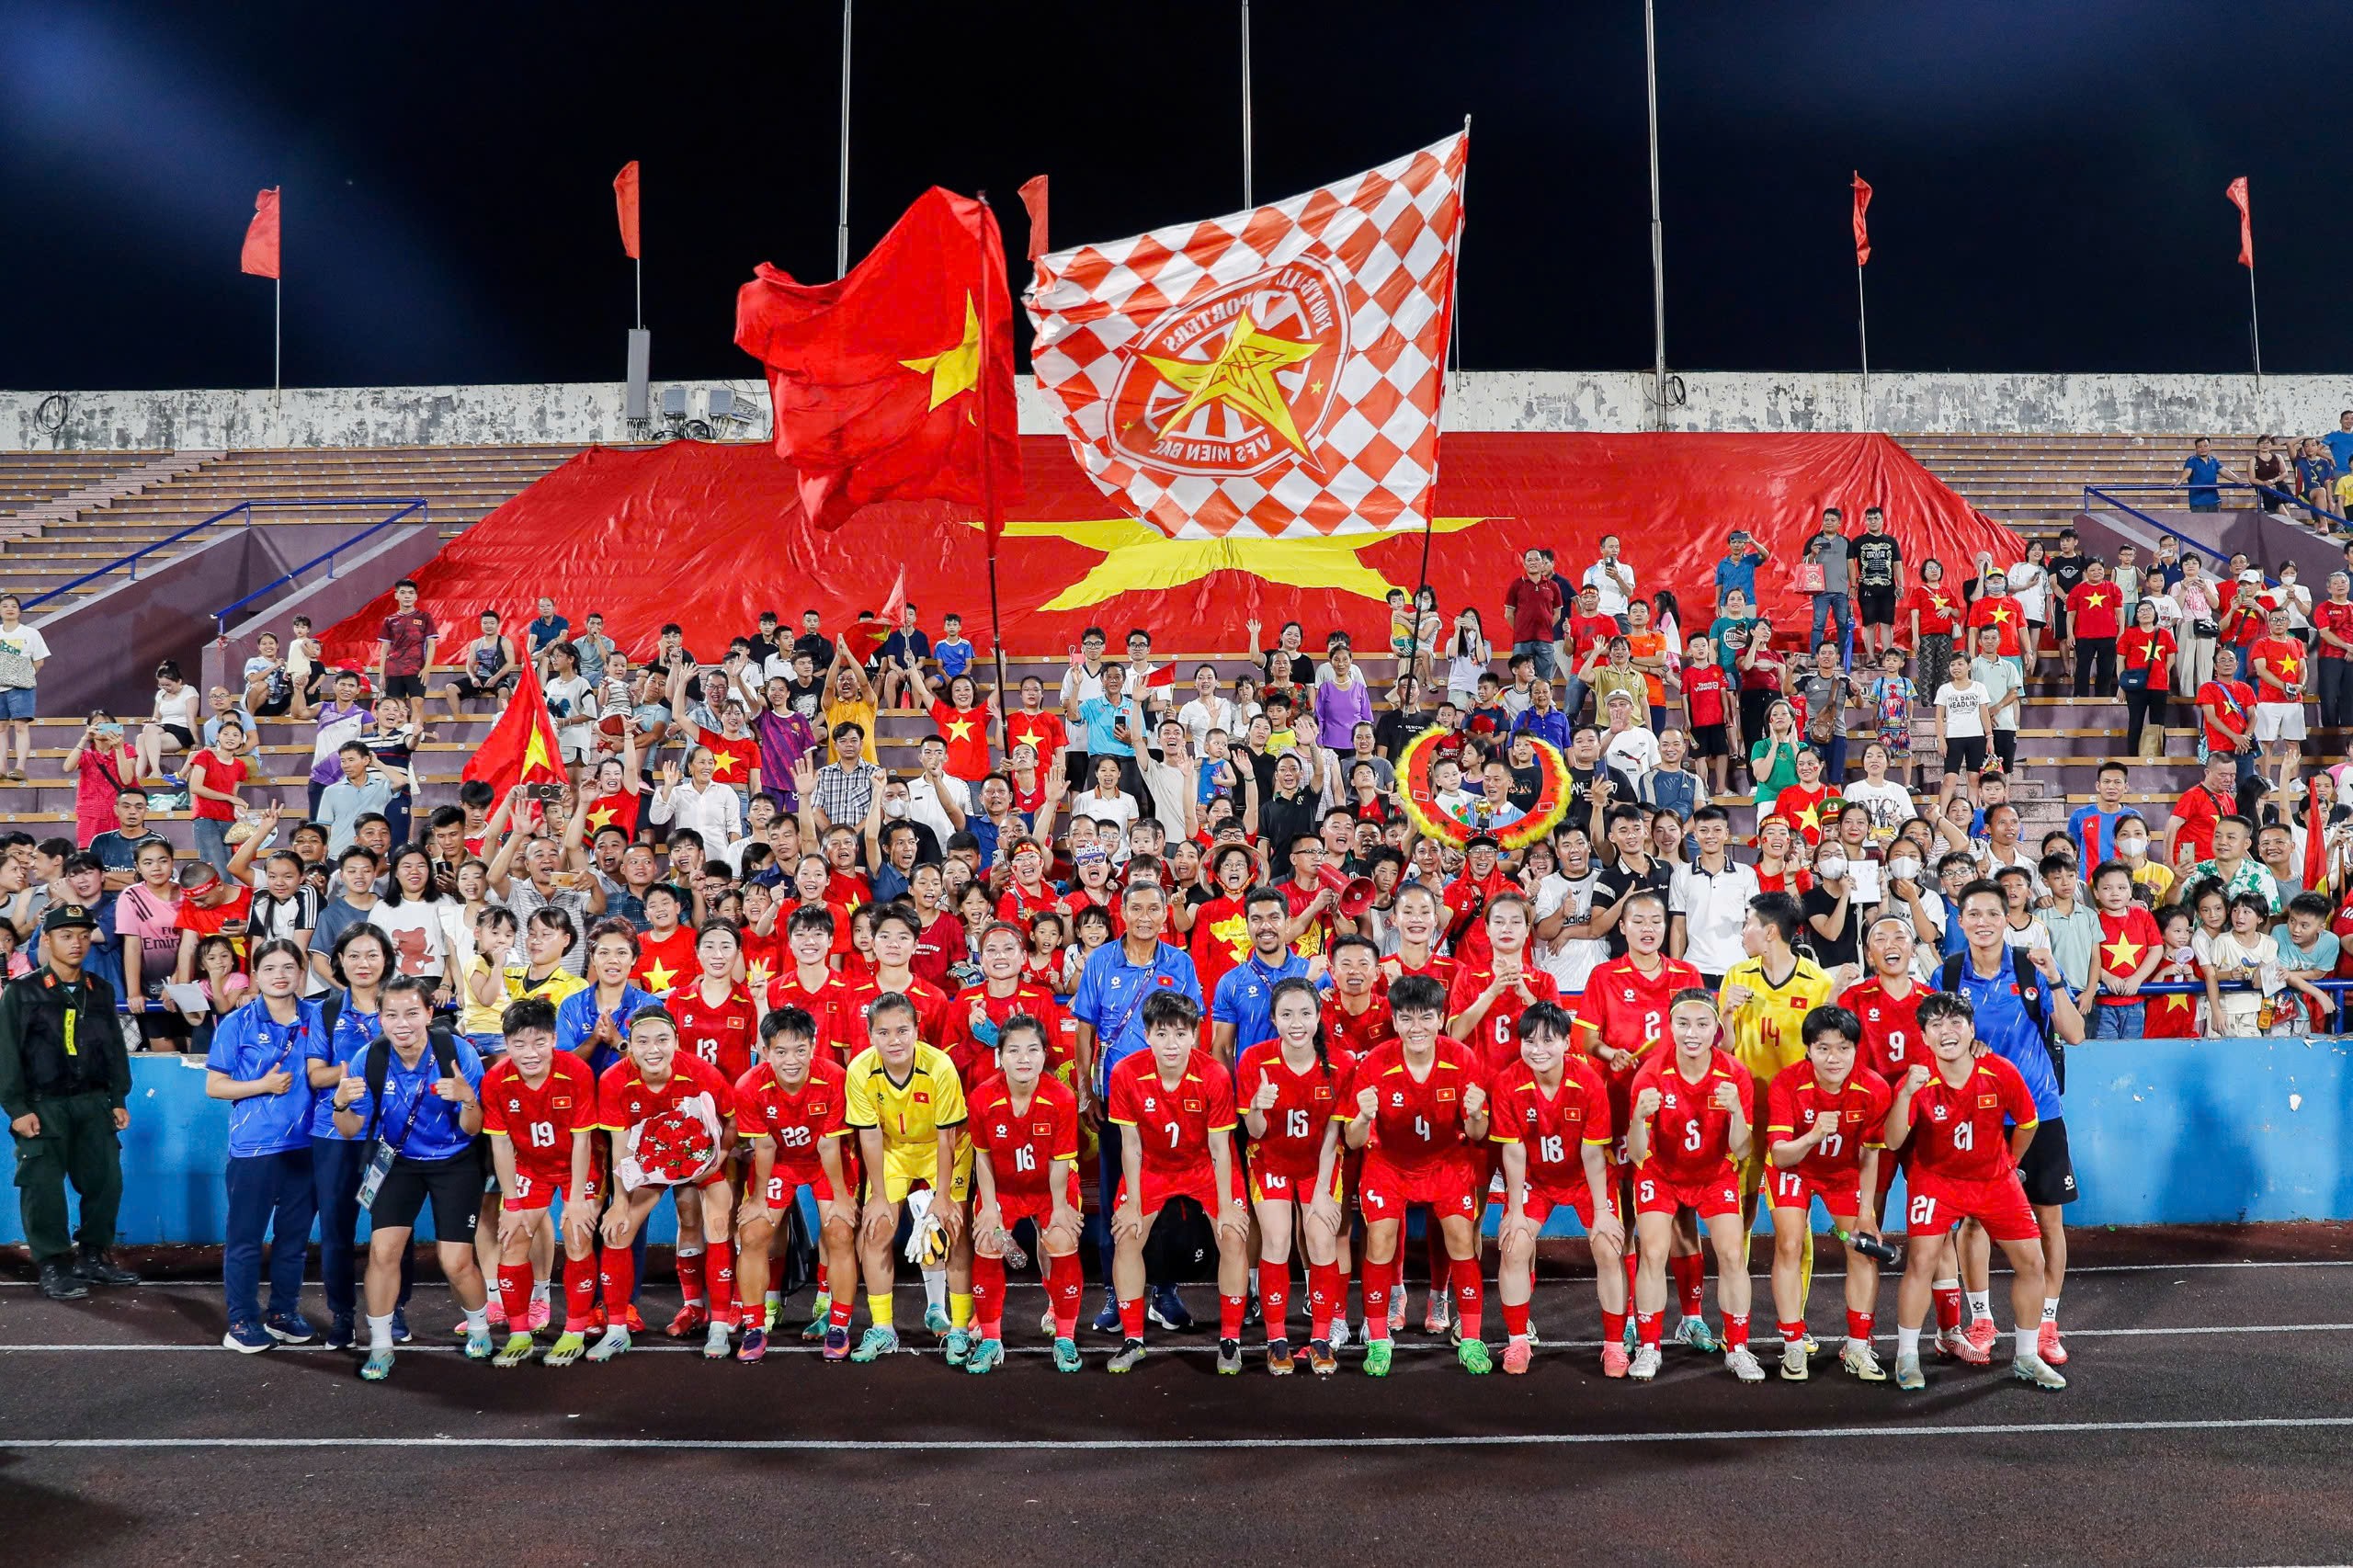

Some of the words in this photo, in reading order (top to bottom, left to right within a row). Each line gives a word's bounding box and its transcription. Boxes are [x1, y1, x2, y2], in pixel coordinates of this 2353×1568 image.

[1563, 913, 1592, 926] adida
[1495, 1013, 1511, 1045] 6
[1644, 1010, 1661, 1041] 2
[1759, 1017, 1780, 1047] 14
[697, 1038, 718, 1066] 13
[1888, 1030, 1905, 1062] 9
[530, 1120, 555, 1148] 19
[781, 1125, 812, 1149] 22
[899, 1112, 906, 1135] 1
[1165, 1120, 1179, 1149] 7
[1287, 1108, 1309, 1139] 15
[1415, 1114, 1431, 1142] 4
[1684, 1119, 1700, 1152] 5
[1954, 1120, 1973, 1152] 21
[1015, 1142, 1036, 1173] 16
[1540, 1134, 1565, 1164] 18
[1818, 1134, 1844, 1158] 17
[514, 1175, 532, 1199] 9
[1779, 1171, 1802, 1198] 17
[1909, 1194, 1937, 1225] 21
